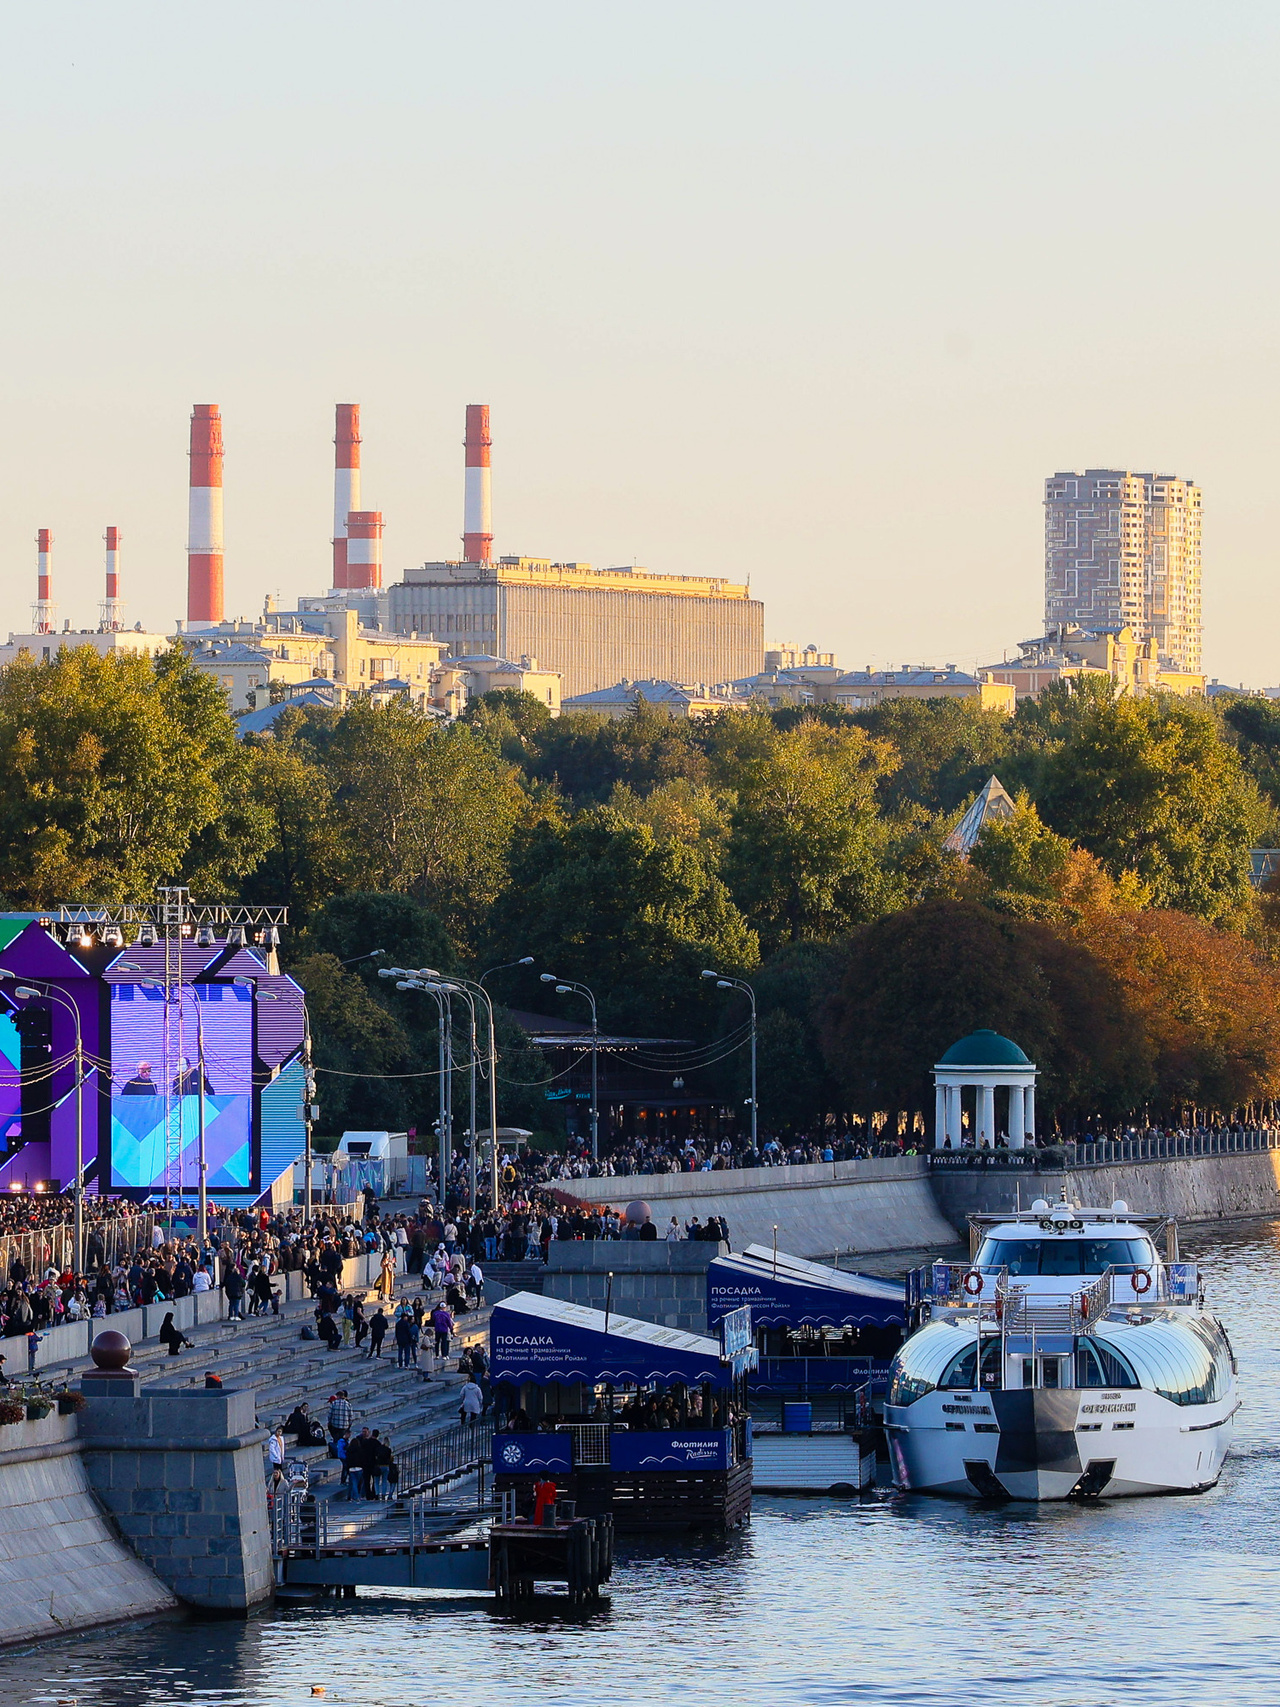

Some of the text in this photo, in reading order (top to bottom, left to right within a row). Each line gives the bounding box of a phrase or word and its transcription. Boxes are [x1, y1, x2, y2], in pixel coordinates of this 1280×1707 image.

[711, 1287, 762, 1296] ПОСАДКА
[496, 1335, 554, 1346] ПОСАДКА
[530, 1346, 571, 1354] трамвайчики
[671, 1440, 719, 1449] Флотилия
